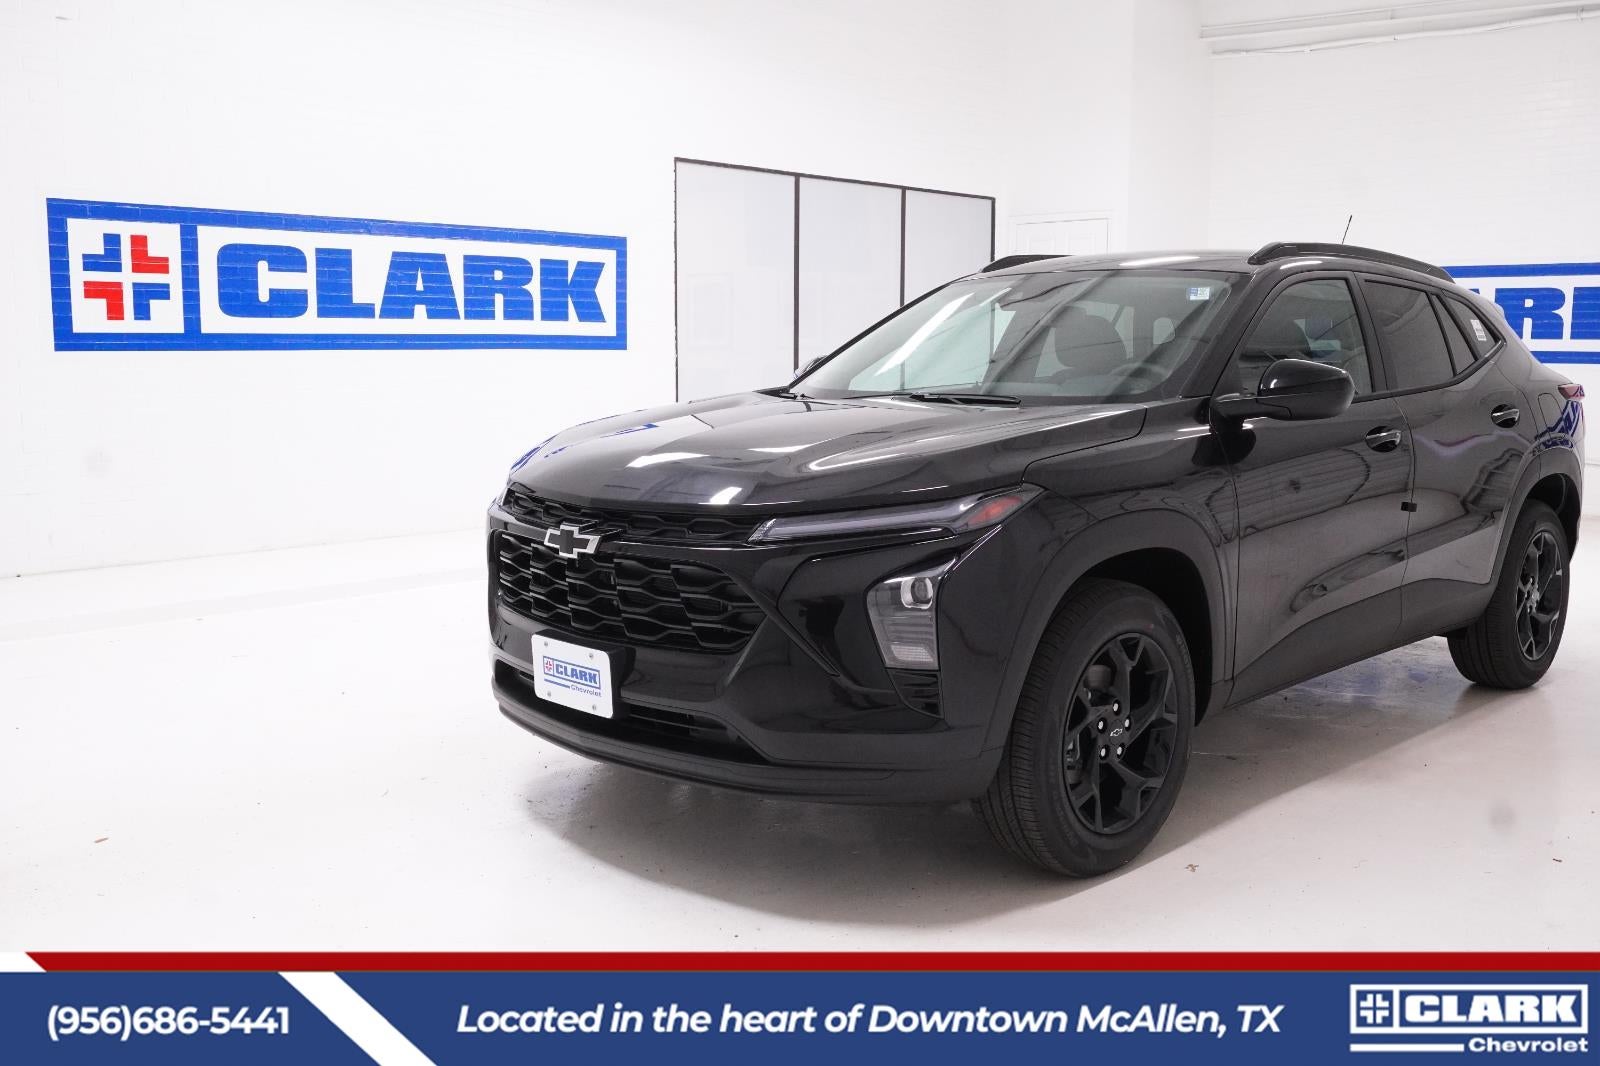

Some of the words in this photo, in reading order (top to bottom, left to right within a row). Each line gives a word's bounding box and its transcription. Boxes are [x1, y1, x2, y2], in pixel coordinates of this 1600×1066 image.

[217, 243, 606, 322] CLARK
[555, 663, 598, 684] CLARK
[570, 684, 602, 697] Chevrolet
